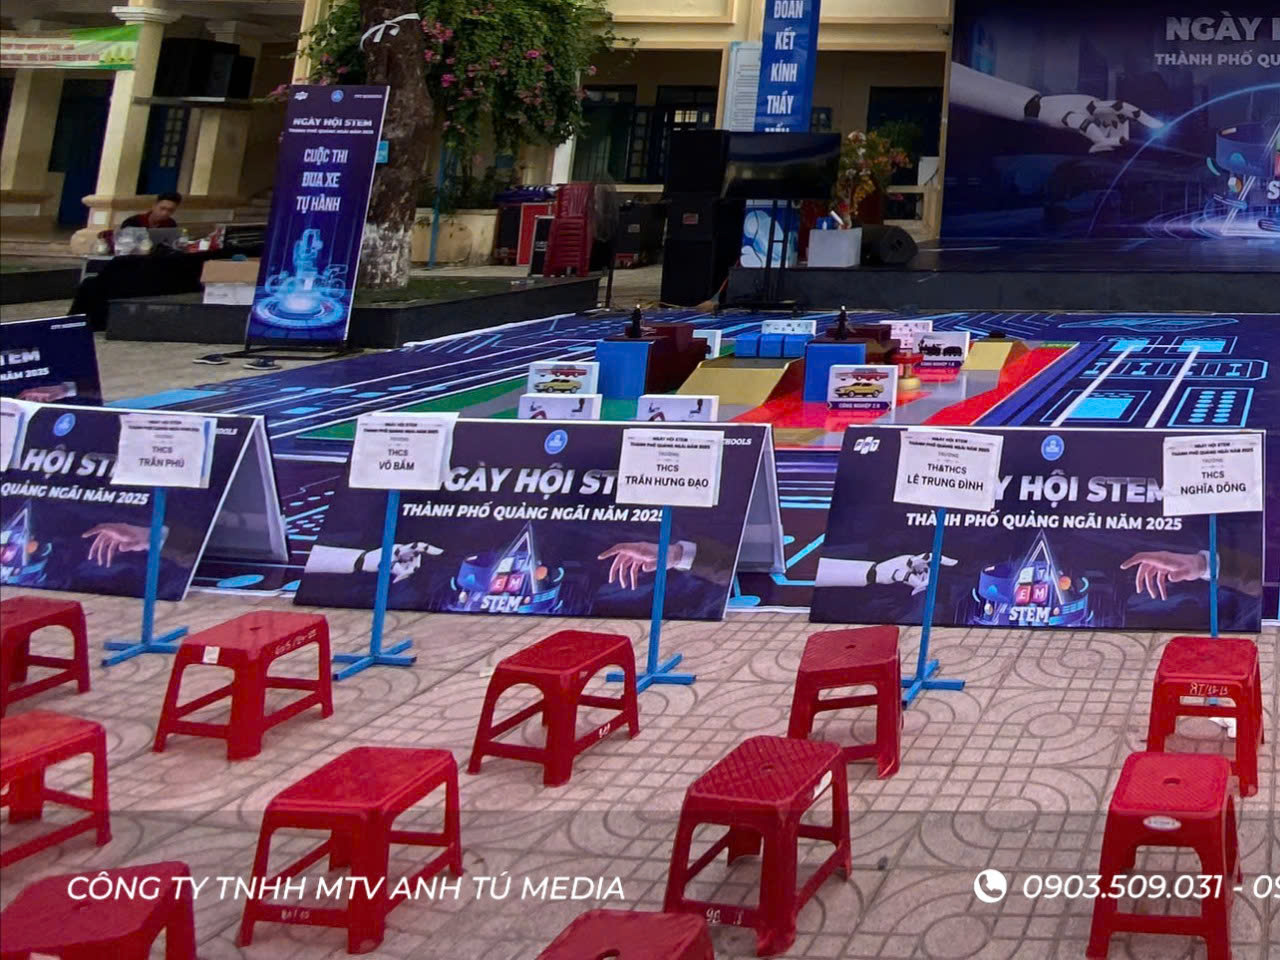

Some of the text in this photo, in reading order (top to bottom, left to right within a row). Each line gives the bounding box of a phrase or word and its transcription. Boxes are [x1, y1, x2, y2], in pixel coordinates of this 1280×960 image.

[1166, 12, 1262, 41] NGÀY
[775, 27, 796, 50] KẾT
[1155, 51, 1212, 66] THÀNH
[1218, 50, 1252, 66] PHỐ
[771, 60, 797, 82] KÍNH
[304, 146, 349, 166] CUỘC THI
[301, 171, 341, 188] ĐUA XE
[296, 193, 341, 214] TỰ HÀNH
[21, 444, 76, 479] HỘI
[656, 464, 679, 472] THCS
[443, 462, 575, 500] GÀY HỘI
[654, 476, 709, 489] HƯNG ĐẠO
[907, 473, 919, 484] LÊ
[922, 476, 955, 488] TRUNG
[958, 479, 984, 491] ĐÌNH
[1202, 471, 1225, 479] THCS
[1020, 469, 1078, 508] HỘI
[1181, 483, 1214, 495] NGHĨA
[116, 492, 150, 505] 2025
[403, 501, 452, 517] THÀNH
[457, 501, 493, 517] PHỐ
[493, 503, 548, 521] QUẢNG
[551, 505, 588, 521] NGÃI
[592, 505, 628, 521] NĂM
[965, 509, 1182, 531] PHỐ QUẢNG NGÃI NĂM 2025
[481, 595, 523, 612] STEM
[1009, 607, 1051, 623] STEM
